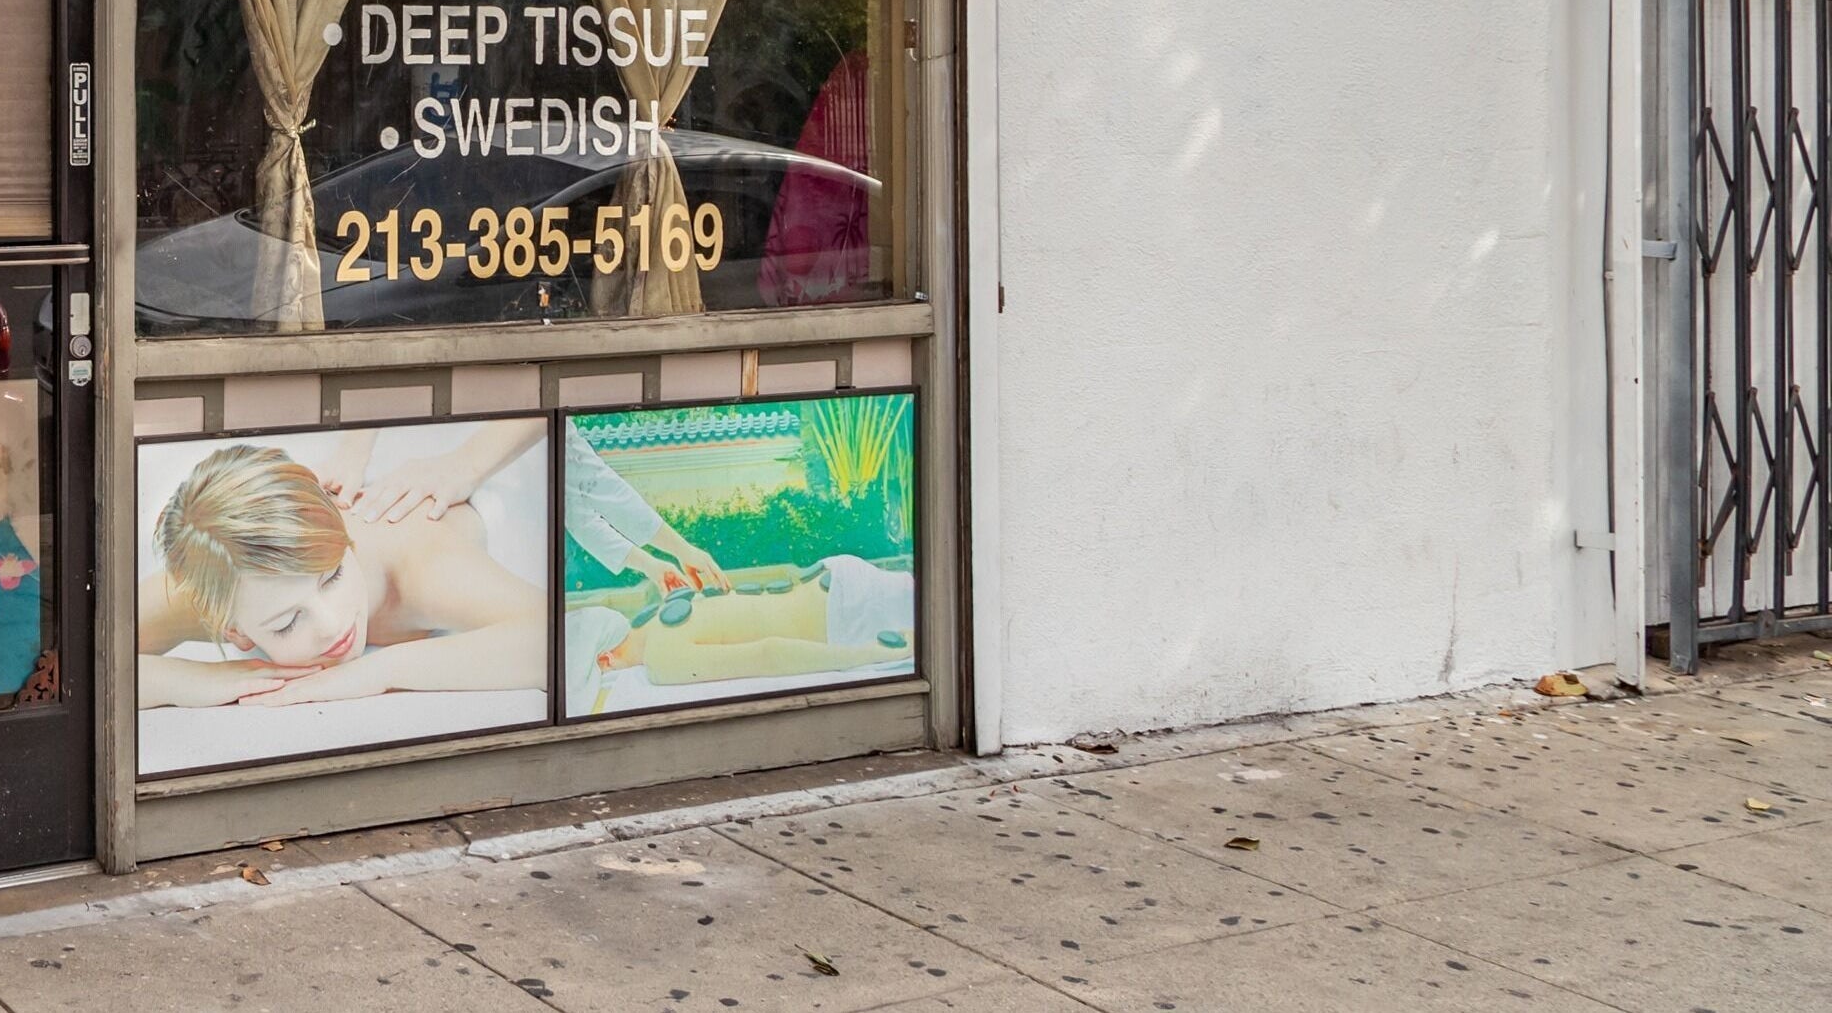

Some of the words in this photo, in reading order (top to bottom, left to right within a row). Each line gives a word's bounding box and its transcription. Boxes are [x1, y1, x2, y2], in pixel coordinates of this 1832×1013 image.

[361, 4, 508, 65] DEEP
[523, 5, 709, 67] TISSUE
[73, 72, 87, 138] PULL
[413, 96, 659, 159] SWEDISH
[335, 202, 724, 282] 213-385-5169
